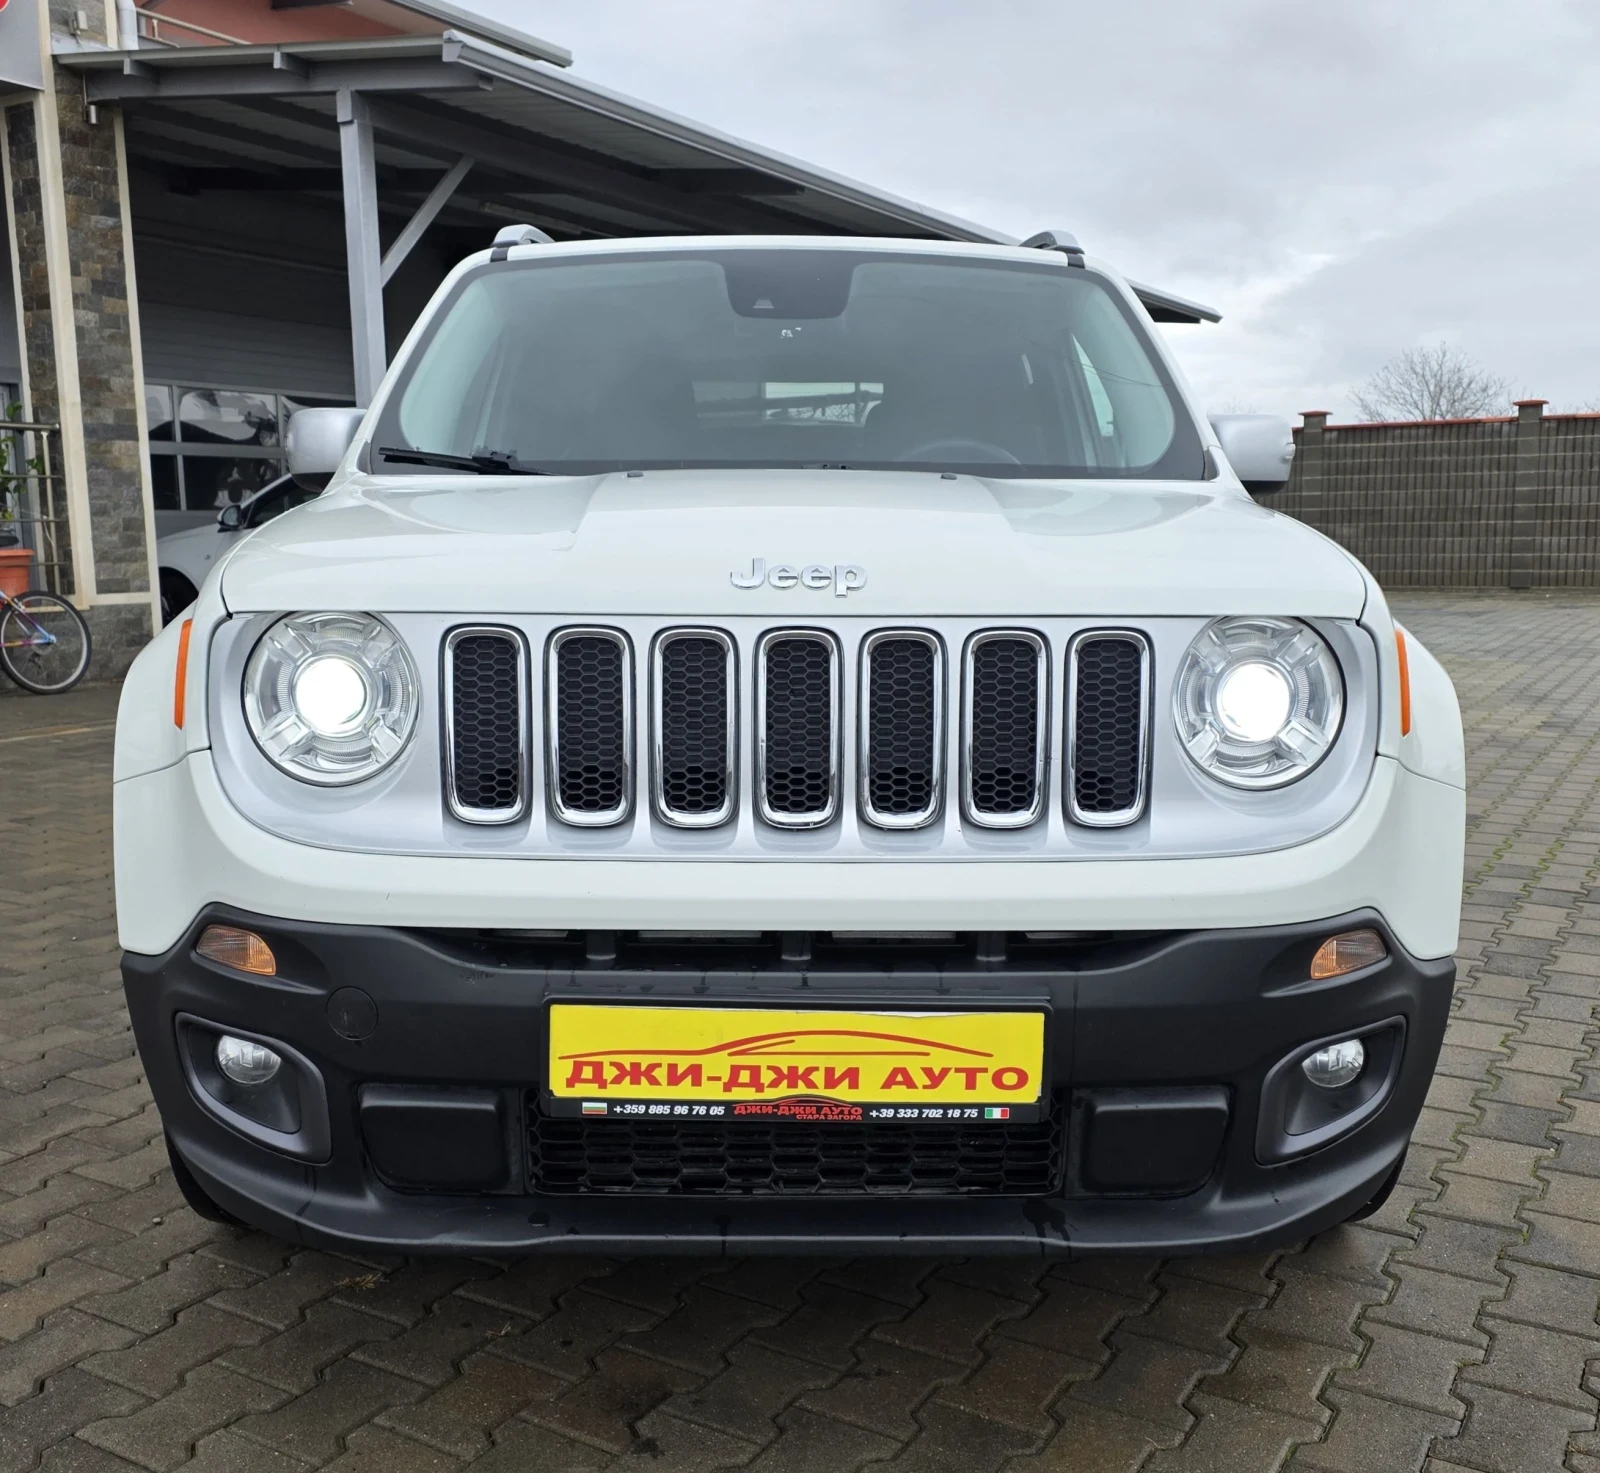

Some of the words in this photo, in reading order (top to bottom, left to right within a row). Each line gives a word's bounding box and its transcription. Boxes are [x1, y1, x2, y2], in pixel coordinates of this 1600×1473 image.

[730, 557, 867, 598] Jeep
[565, 1060, 860, 1093] ДЖИ-ДЖИ
[880, 1066, 1029, 1091] АУТО
[613, 1104, 646, 1114] +359
[648, 1105, 671, 1115] 885
[673, 1105, 689, 1116] 96
[692, 1105, 707, 1116] 76
[709, 1106, 725, 1116] 05
[734, 1105, 817, 1115] ДЖИ-ДЖИ
[821, 1106, 863, 1115] АУТО
[869, 1108, 895, 1118] +39
[896, 1108, 919, 1118] 333
[921, 1108, 944, 1118] 702
[946, 1109, 961, 1118] 18
[963, 1109, 979, 1118] 75
